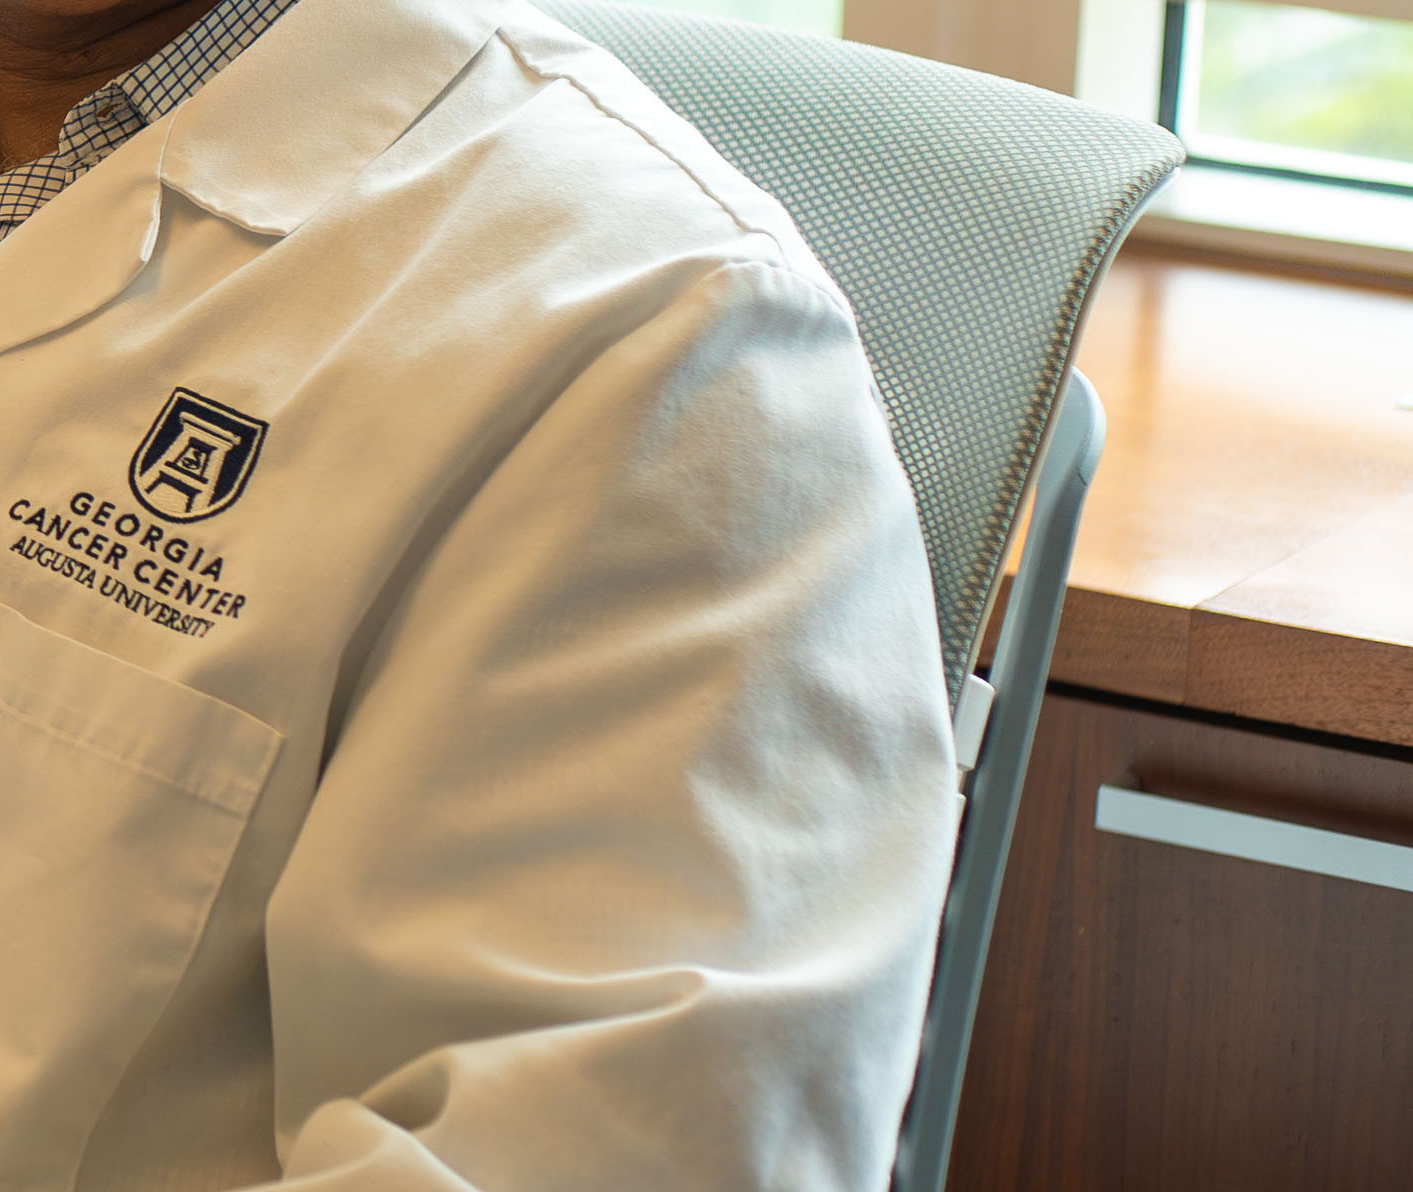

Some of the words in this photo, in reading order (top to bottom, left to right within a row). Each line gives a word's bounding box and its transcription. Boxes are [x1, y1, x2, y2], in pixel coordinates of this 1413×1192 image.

[8, 499, 129, 570] CANCER
[134, 559, 247, 619] CENTER
[10, 536, 98, 589] AUGUSTA
[100, 575, 216, 638] UNIVERSITY
[70, 491, 224, 582] GEORGIA
